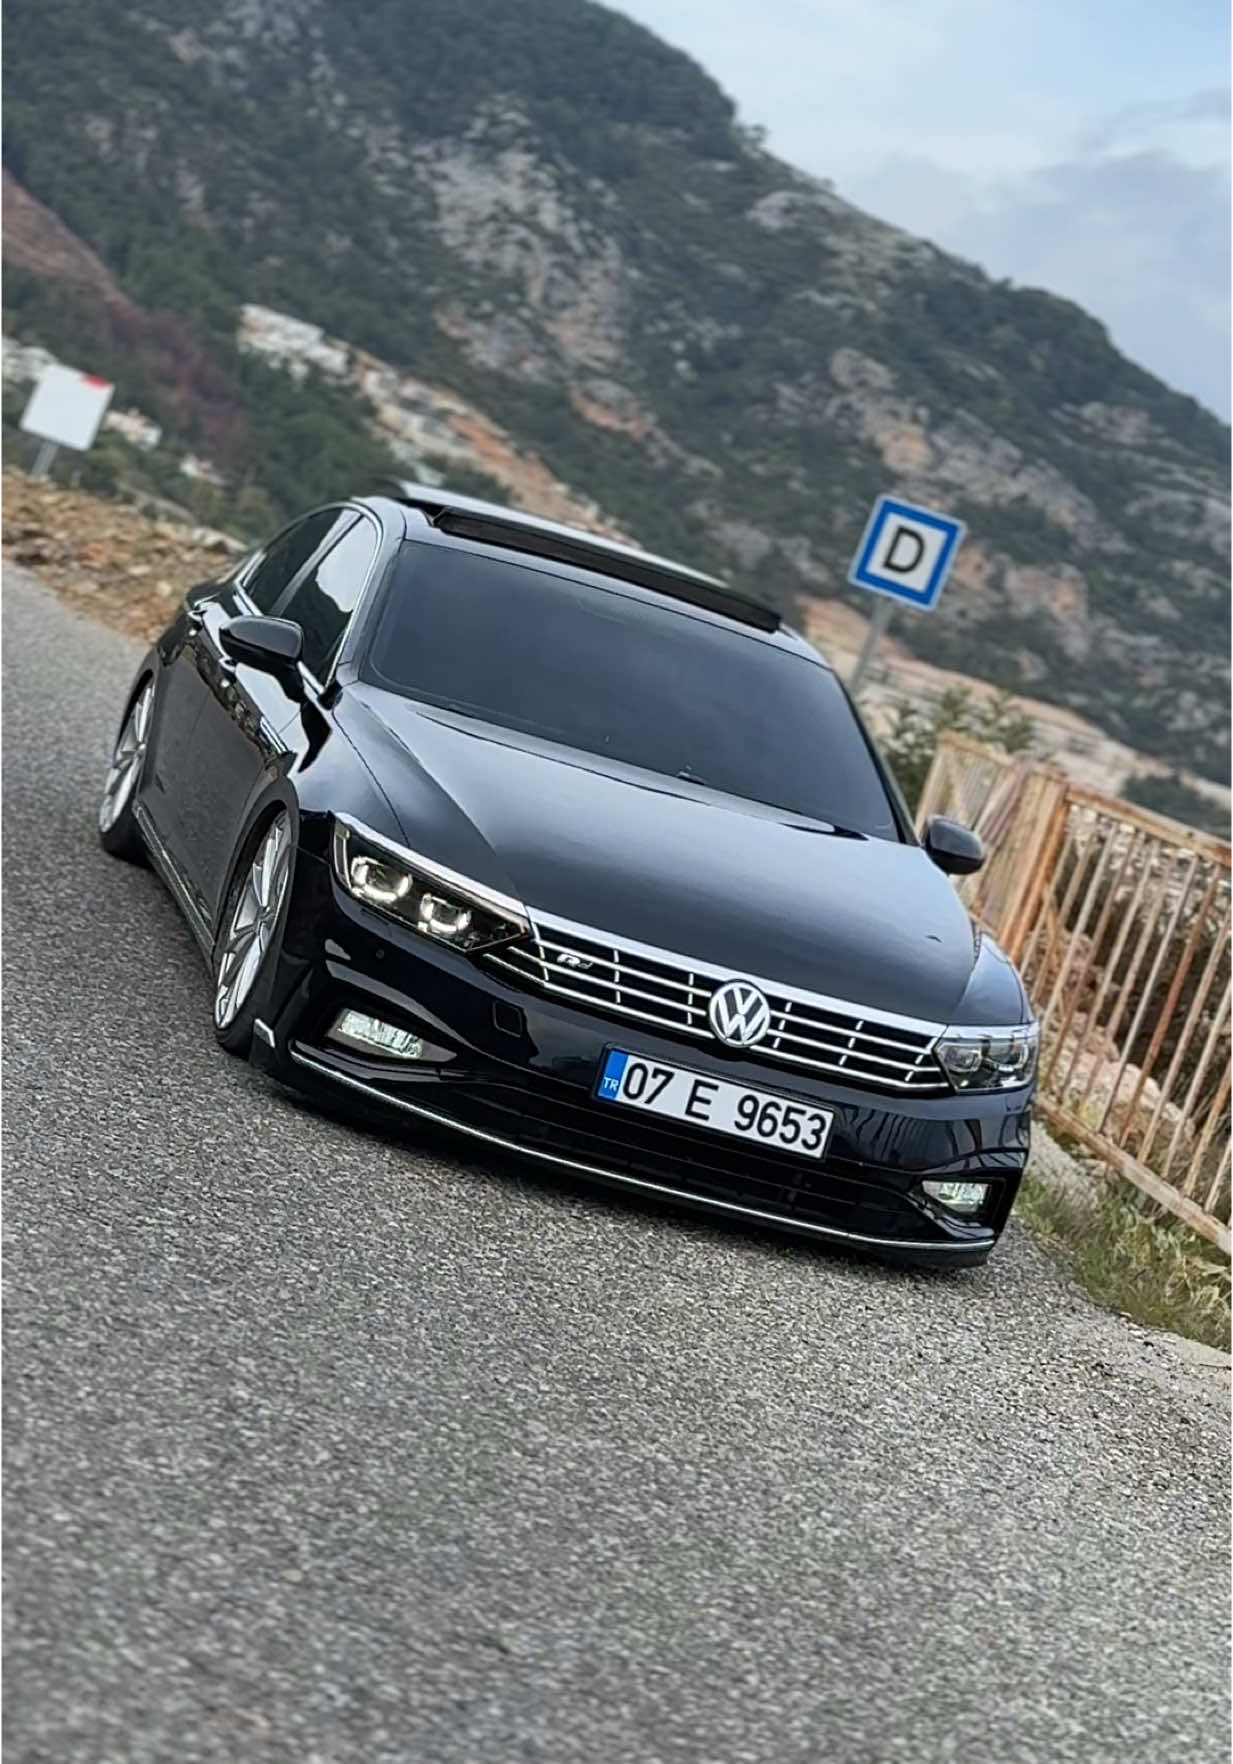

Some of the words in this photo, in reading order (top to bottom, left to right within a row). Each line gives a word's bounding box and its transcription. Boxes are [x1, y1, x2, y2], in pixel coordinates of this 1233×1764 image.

[883, 526, 925, 574] D
[711, 982, 770, 1046] VW
[603, 1076, 619, 1092] TR
[623, 1062, 675, 1104] 07
[685, 1079, 719, 1121] E
[734, 1094, 827, 1150] 9653
